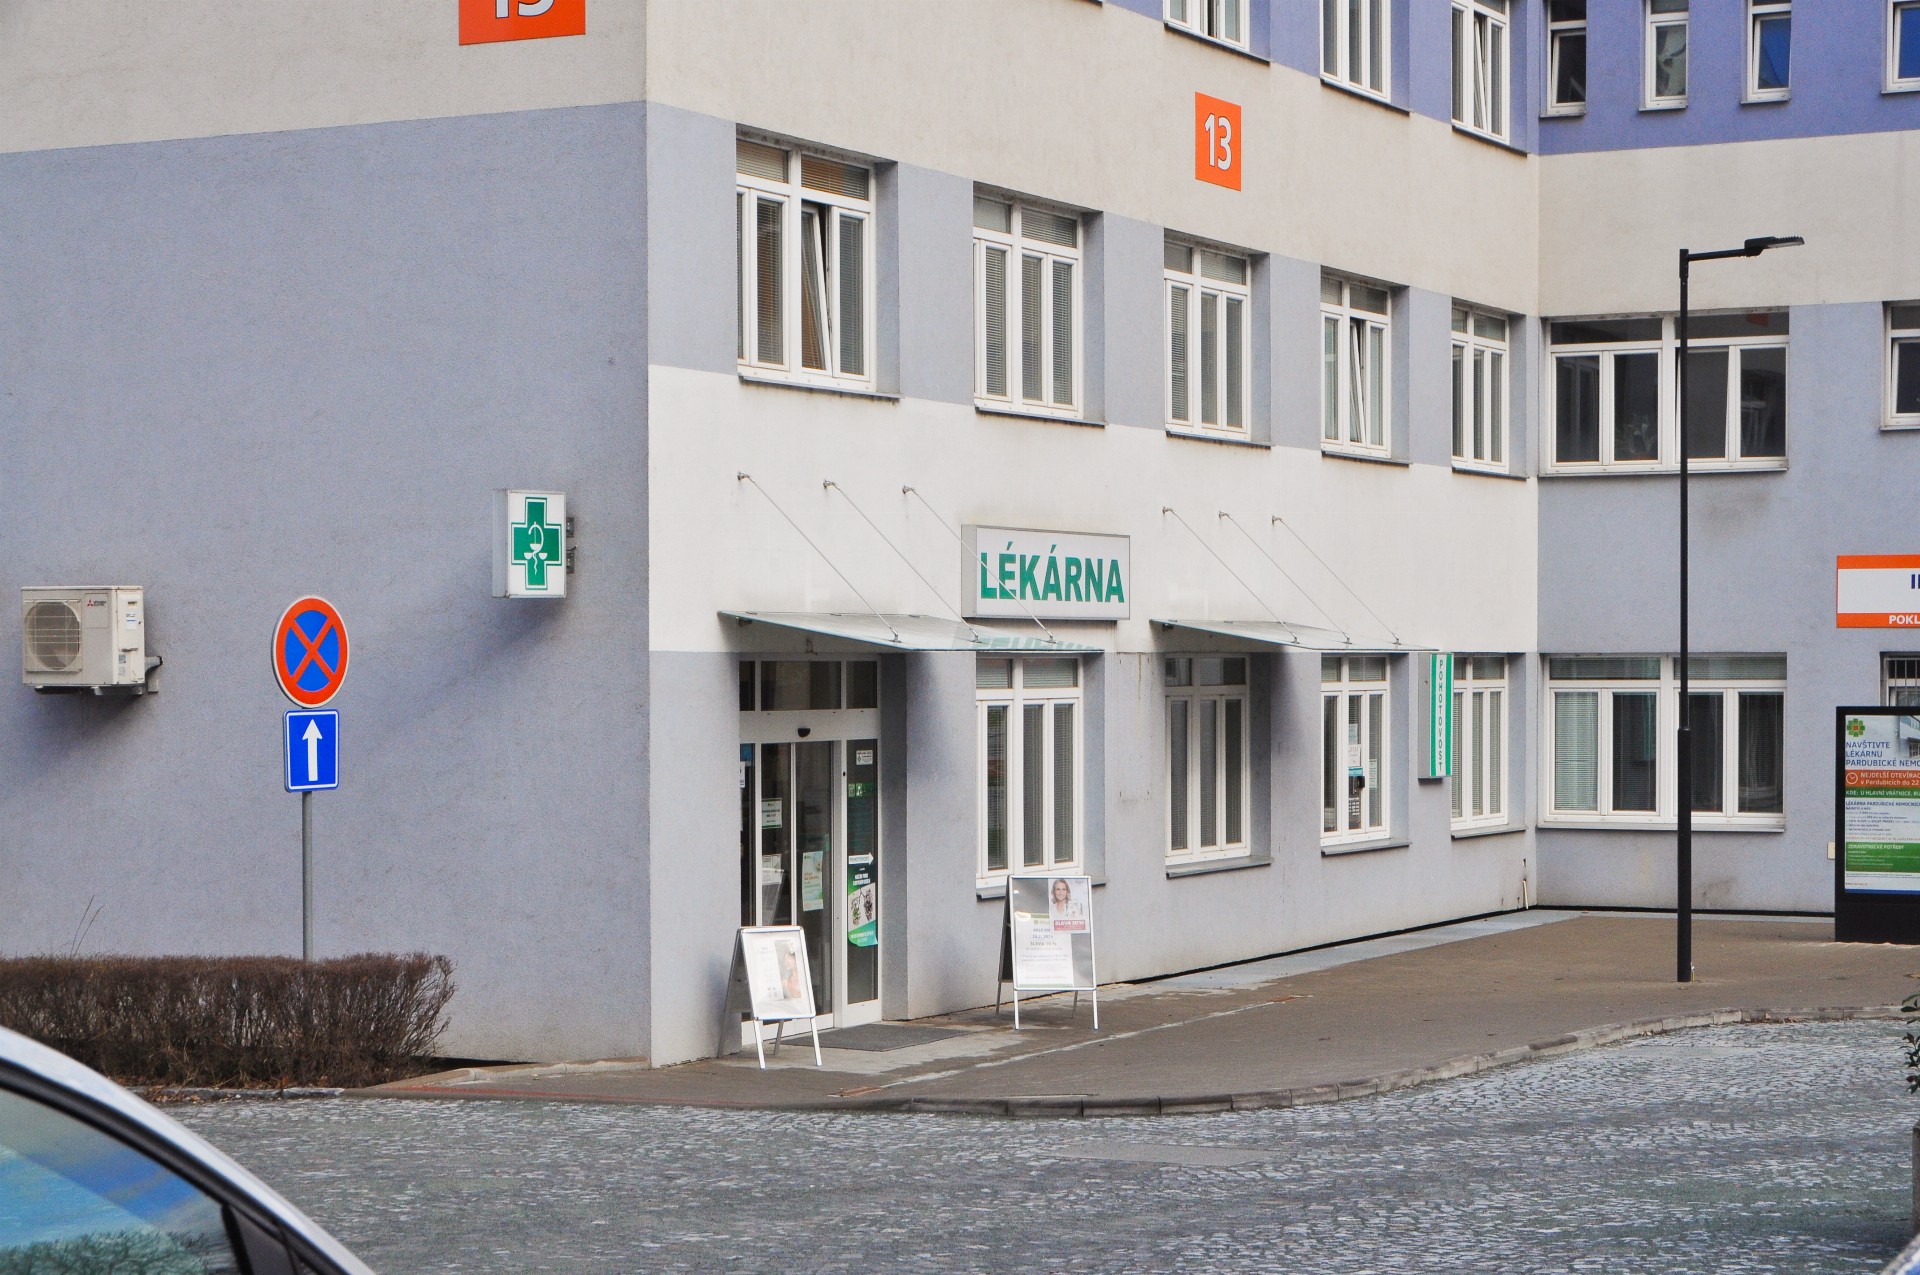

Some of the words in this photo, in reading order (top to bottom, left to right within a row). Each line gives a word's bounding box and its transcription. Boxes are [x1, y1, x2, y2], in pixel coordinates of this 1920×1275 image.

[1204, 112, 1232, 171] 13
[980, 540, 1125, 603] LÉKÁRNA
[1845, 740, 1891, 749] NAVŠTIVTE
[1845, 749, 1883, 758] LÉKÁRNU
[1845, 757, 1897, 767] PARDUBICKÉ
[1860, 771, 1889, 779] NEJDELŠÍ
[1865, 788, 1885, 796] HLAVNÍ
